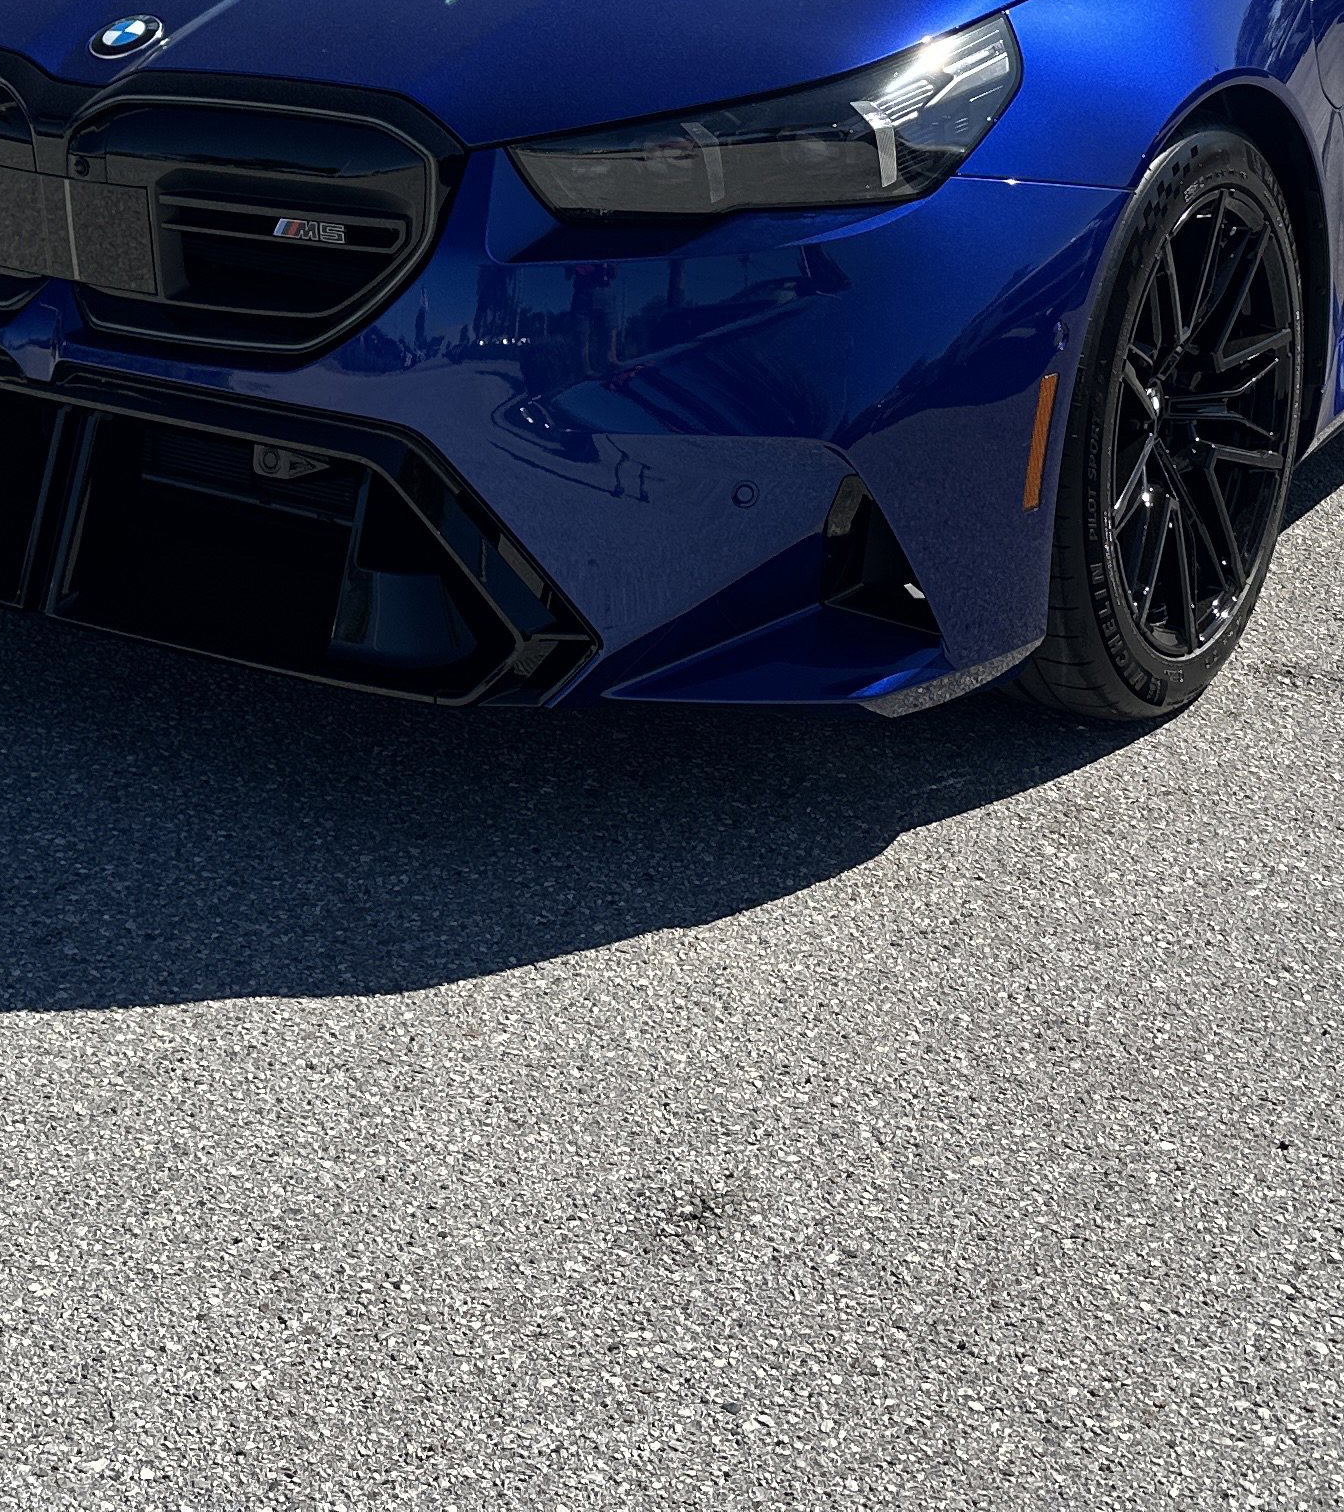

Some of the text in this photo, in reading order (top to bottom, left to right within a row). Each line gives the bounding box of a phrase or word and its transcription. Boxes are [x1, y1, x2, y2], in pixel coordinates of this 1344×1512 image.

[294, 219, 346, 244] M5
[1087, 487, 1098, 541] PILOT
[1089, 562, 1147, 691] MICHELIN
